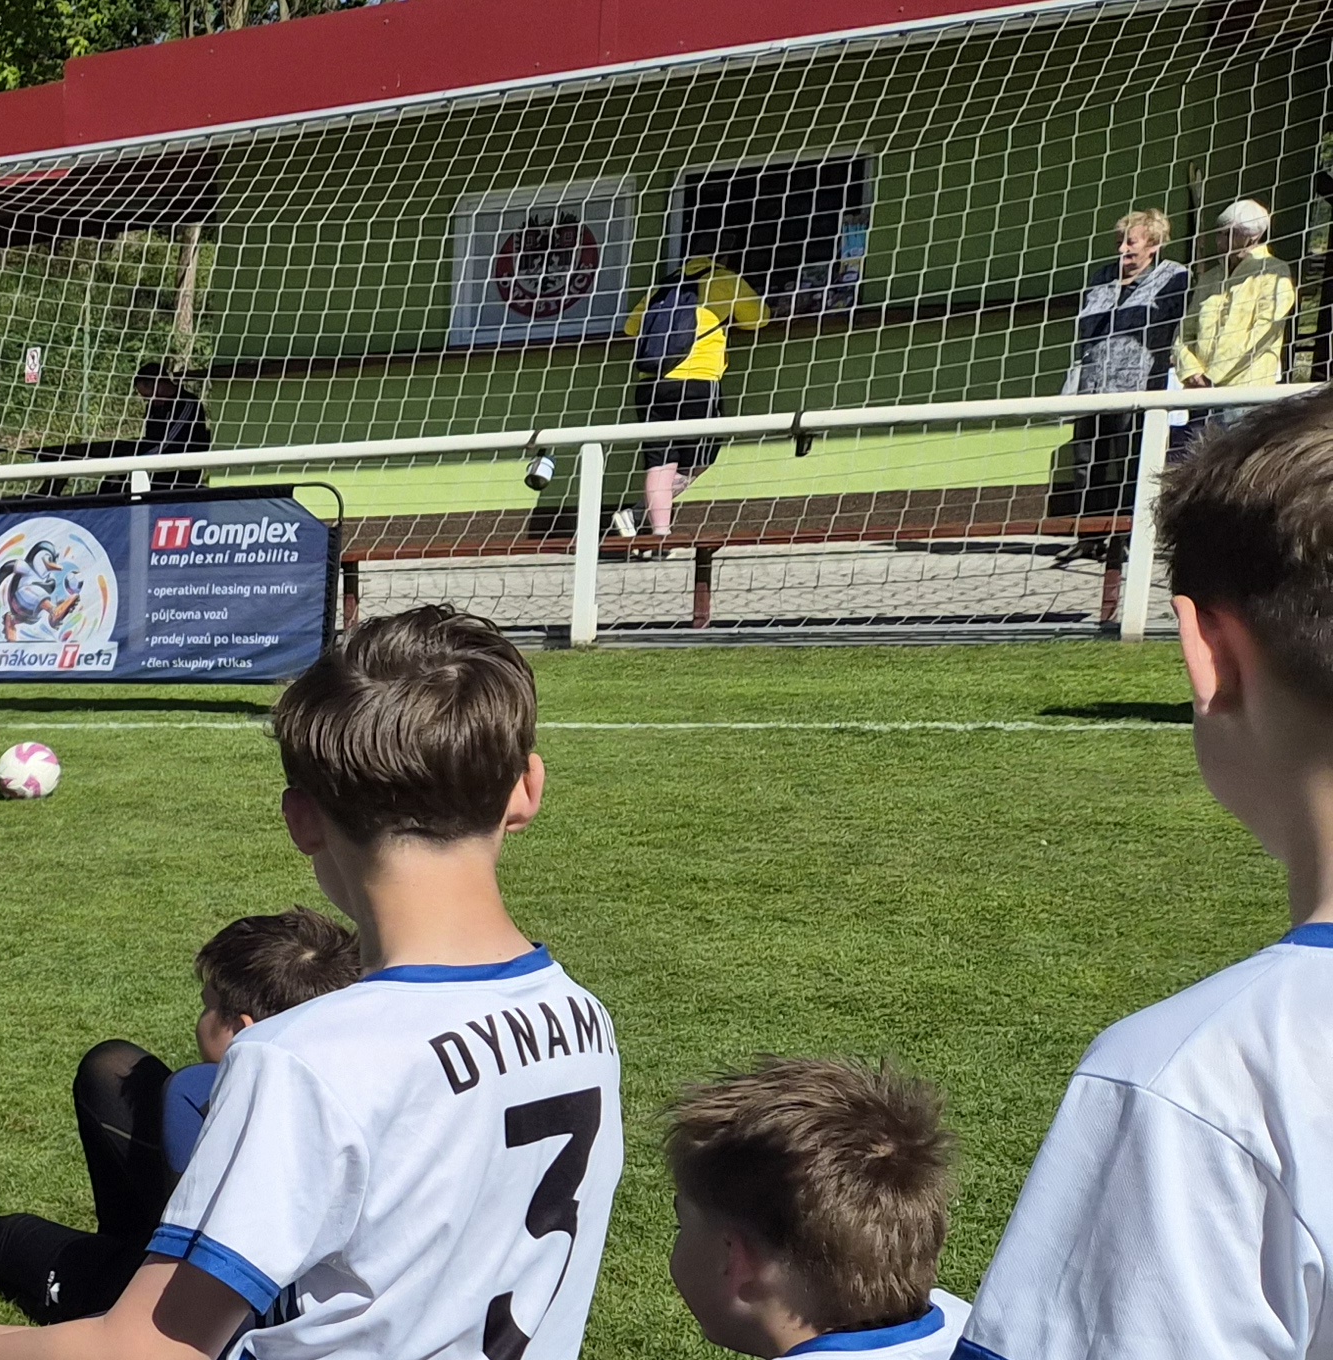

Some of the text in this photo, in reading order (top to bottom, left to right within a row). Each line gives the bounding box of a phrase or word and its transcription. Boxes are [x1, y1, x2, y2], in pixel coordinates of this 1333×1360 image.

[156, 516, 300, 550] TTComplex
[151, 549, 299, 567] komplexní mobilita
[153, 582, 298, 598] operativní leasing na míru
[151, 607, 228, 623] půjčovna vozů
[150, 632, 279, 648] prodej vozů po leasingu
[60, 646, 112, 668] Trefa
[146, 657, 169, 668] člen
[172, 657, 215, 671] skupiny
